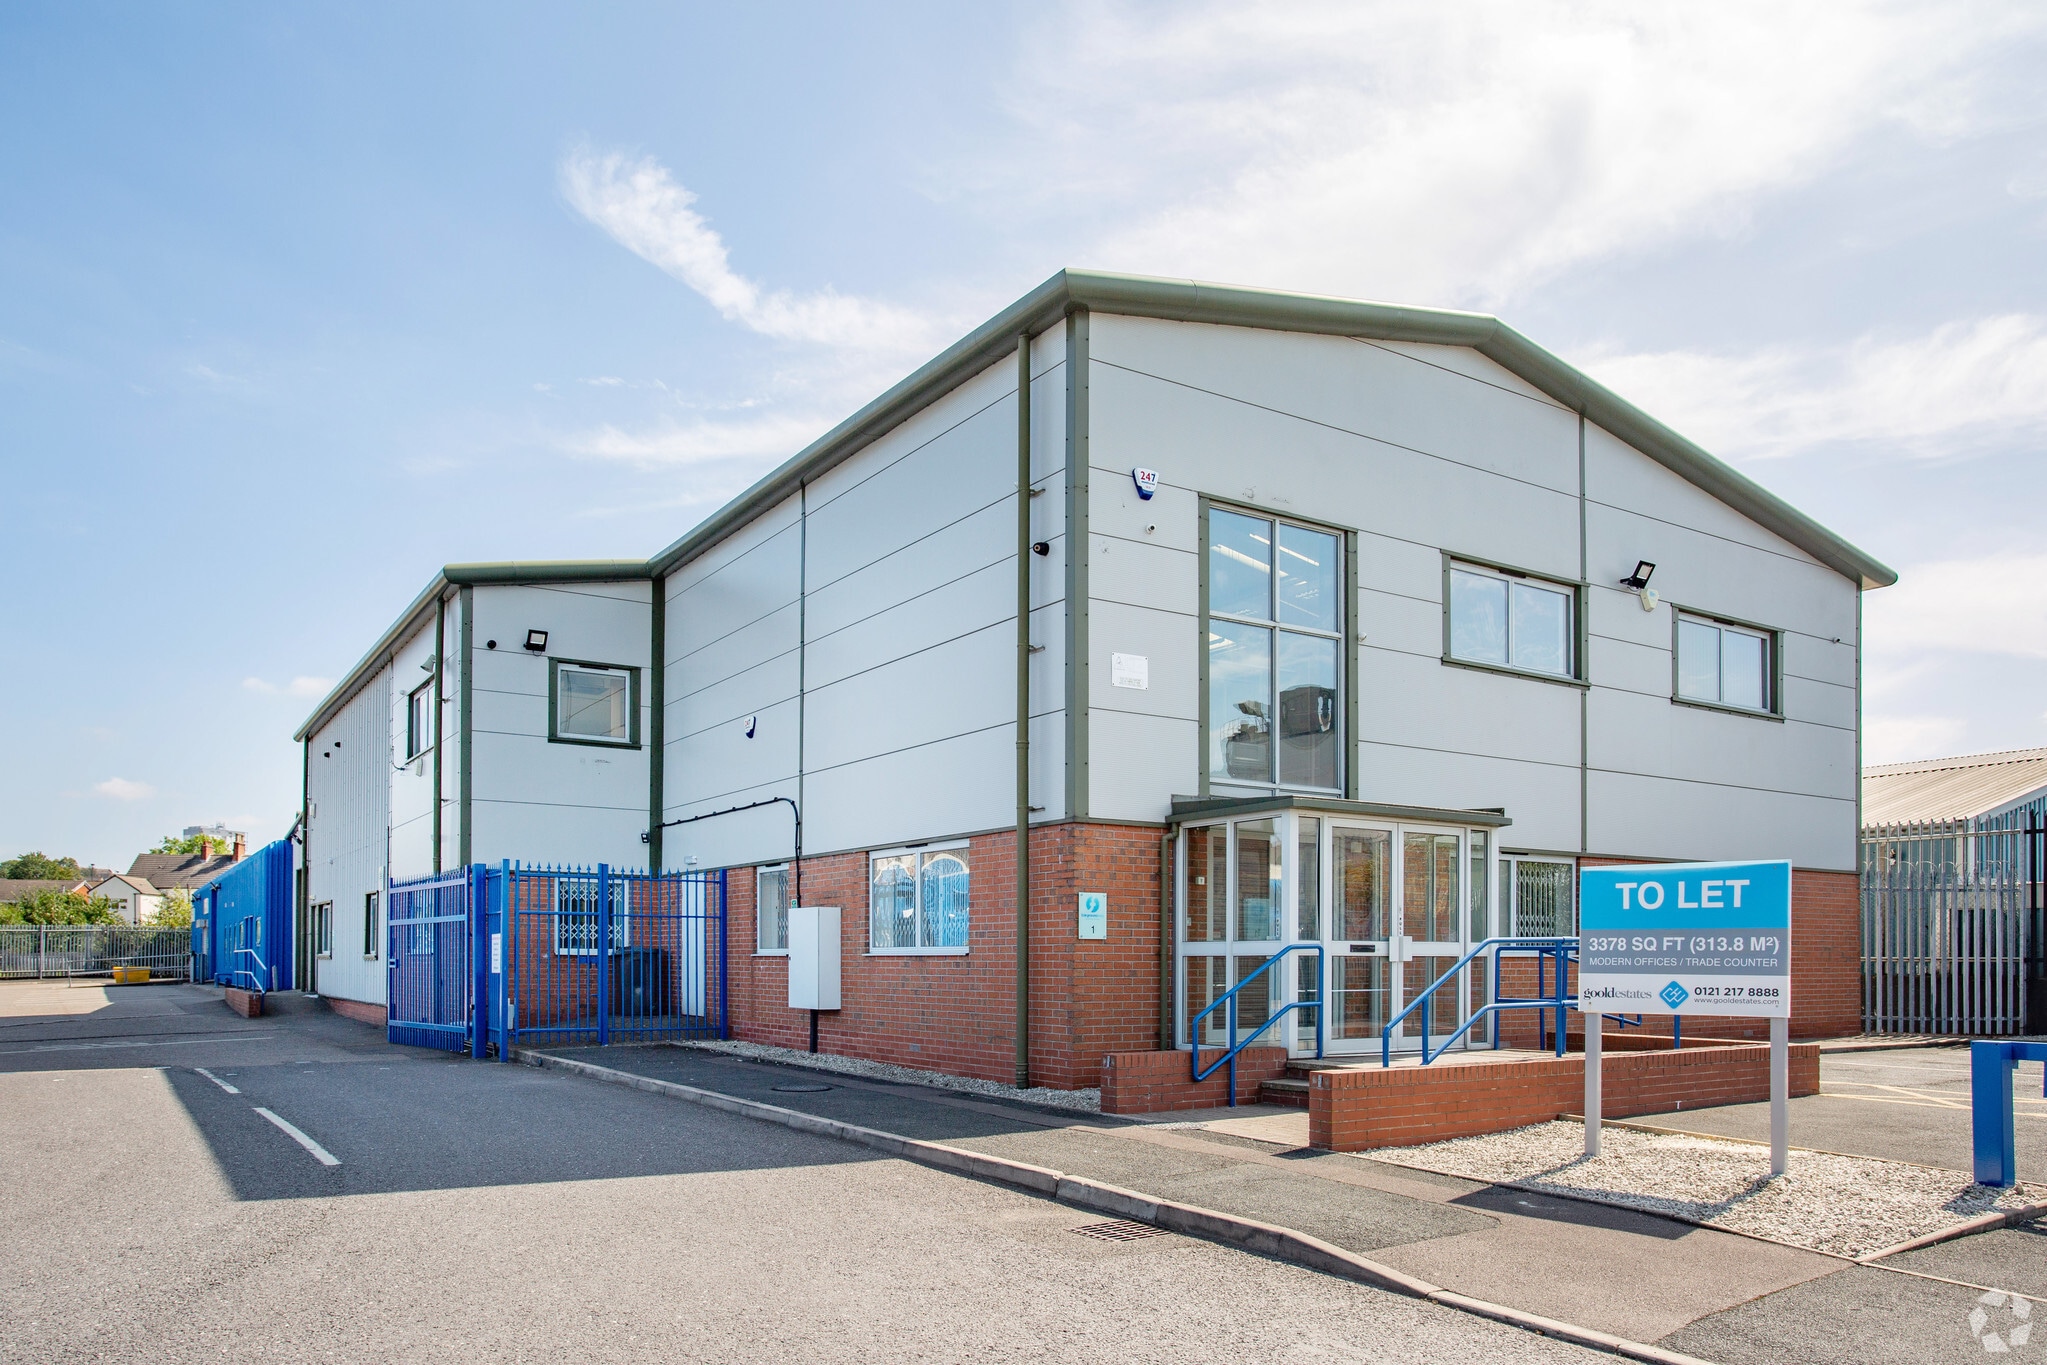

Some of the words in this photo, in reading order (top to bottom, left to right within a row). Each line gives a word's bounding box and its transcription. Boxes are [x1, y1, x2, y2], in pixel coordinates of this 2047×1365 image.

[1140, 471, 1156, 482] 247
[1615, 881, 1665, 910] TO
[1677, 879, 1750, 909] LET
[1589, 937, 1627, 951] 3378
[1631, 936, 1657, 952] SQ
[1662, 937, 1686, 951] FT
[1689, 936, 1744, 955] (313.8
[1589, 957, 1632, 966] MODERN
[1633, 957, 1678, 967] OFFICES
[1685, 957, 1721, 967] TRADE
[1723, 958, 1778, 967] COUNTER
[1583, 986, 1652, 1000] gooldestates
[1694, 986, 1720, 996] 0121
[1723, 987, 1744, 997] 217
[1747, 987, 1780, 997] 8888
[1693, 997, 1780, 1005] www.gooldestates.com
